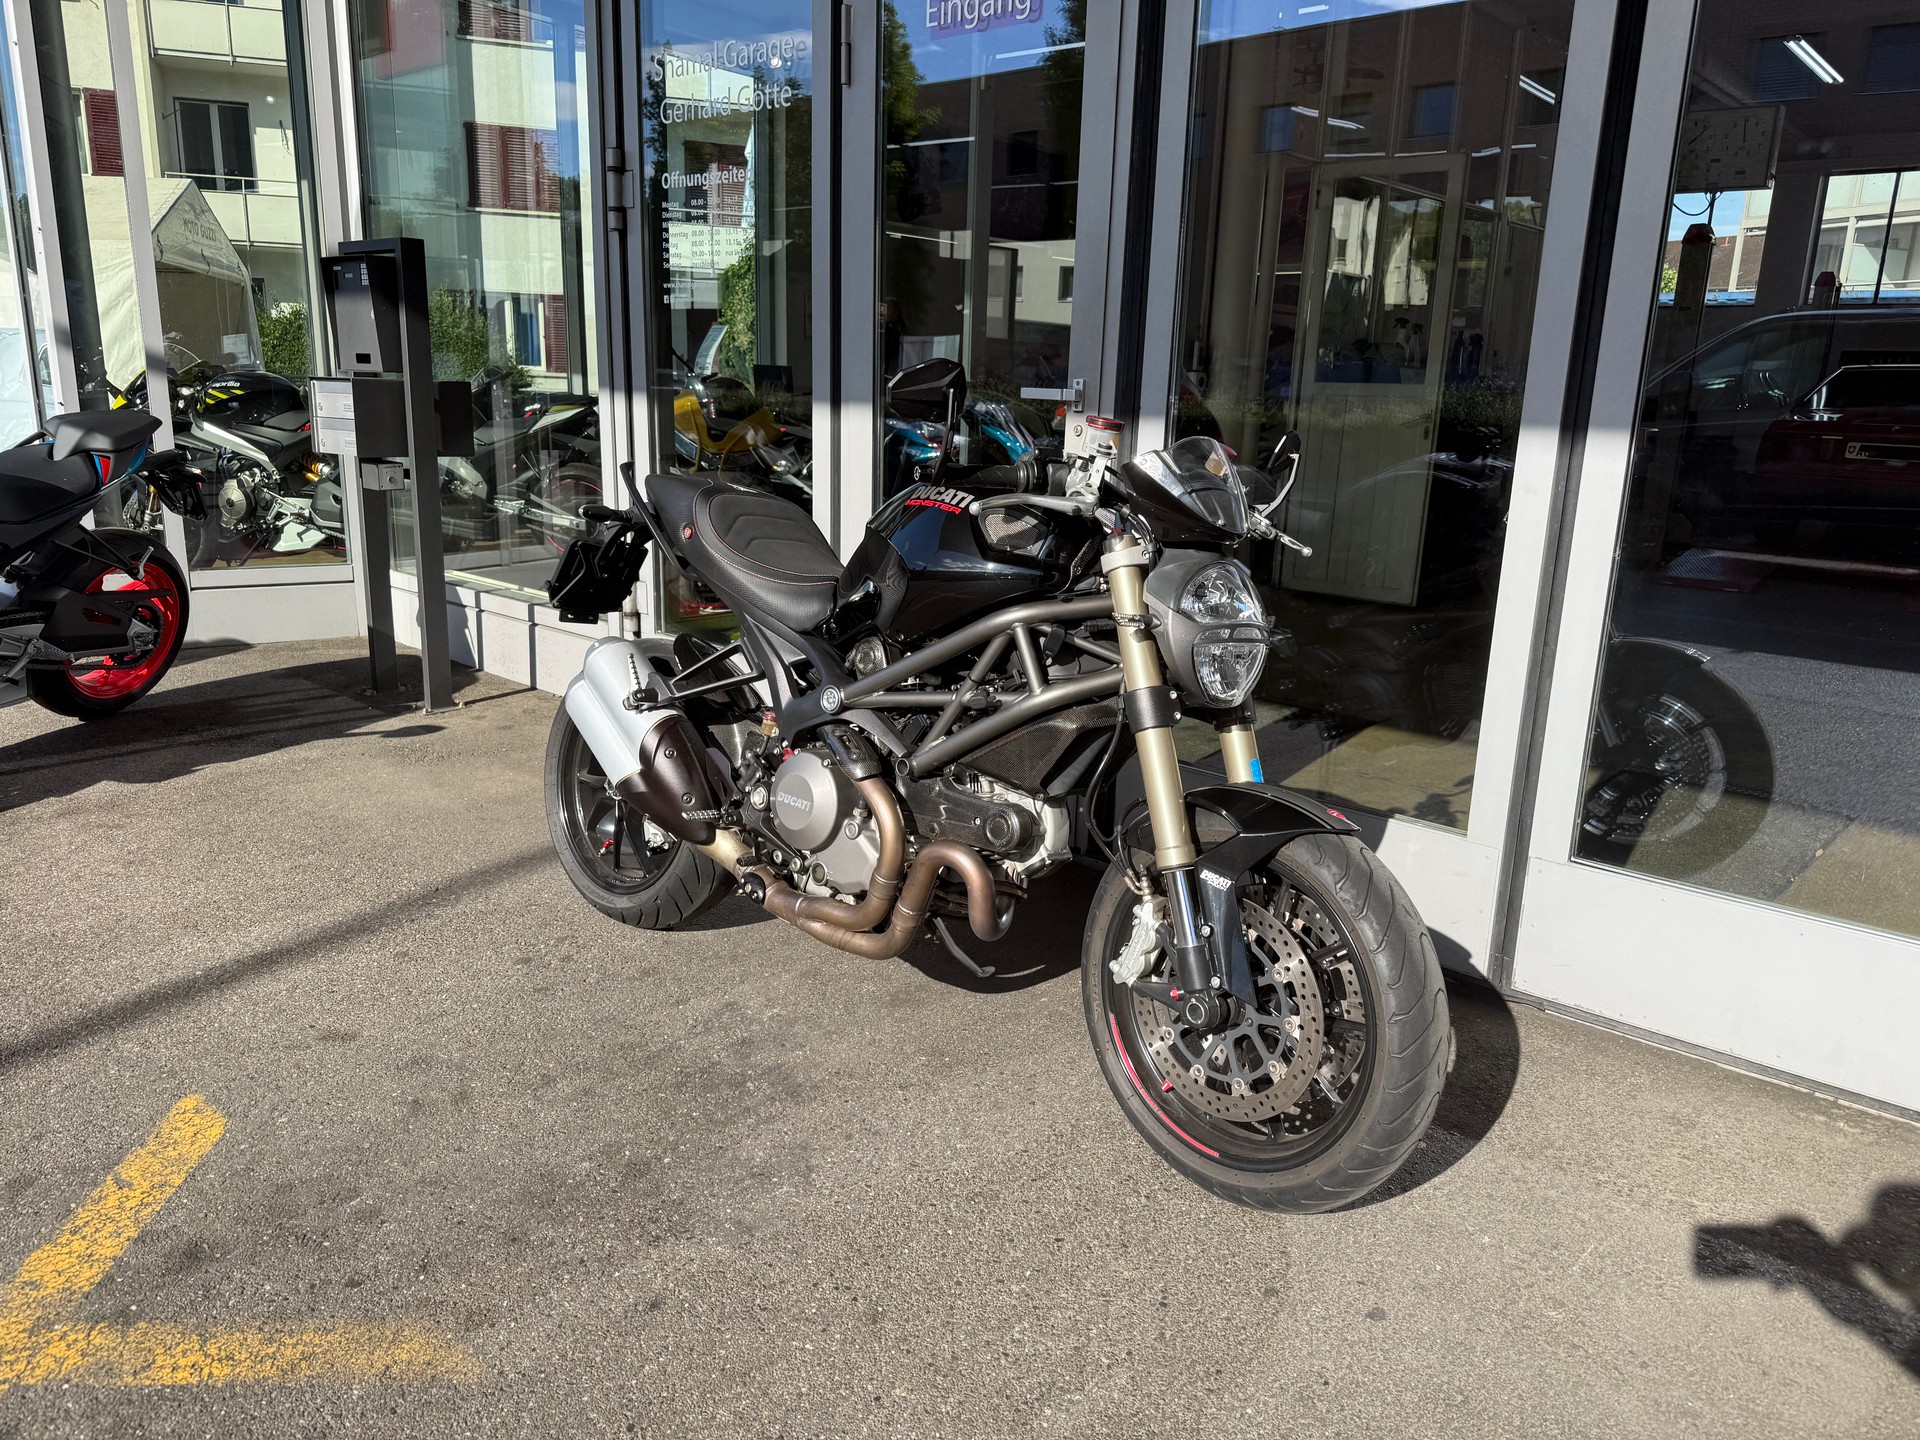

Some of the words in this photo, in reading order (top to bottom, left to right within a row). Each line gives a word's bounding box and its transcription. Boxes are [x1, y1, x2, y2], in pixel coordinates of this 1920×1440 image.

[654, 42, 718, 81] Shamal
[724, 36, 794, 70] Garage
[660, 86, 731, 125] Gerhard
[737, 82, 792, 113] Götte
[662, 201, 680, 209] Montag
[691, 198, 704, 206] 08.00
[662, 211, 682, 220] Dienstag
[905, 498, 962, 515] MONSTER
[911, 486, 975, 509] DUCATI
[777, 791, 811, 812] DUCATI
